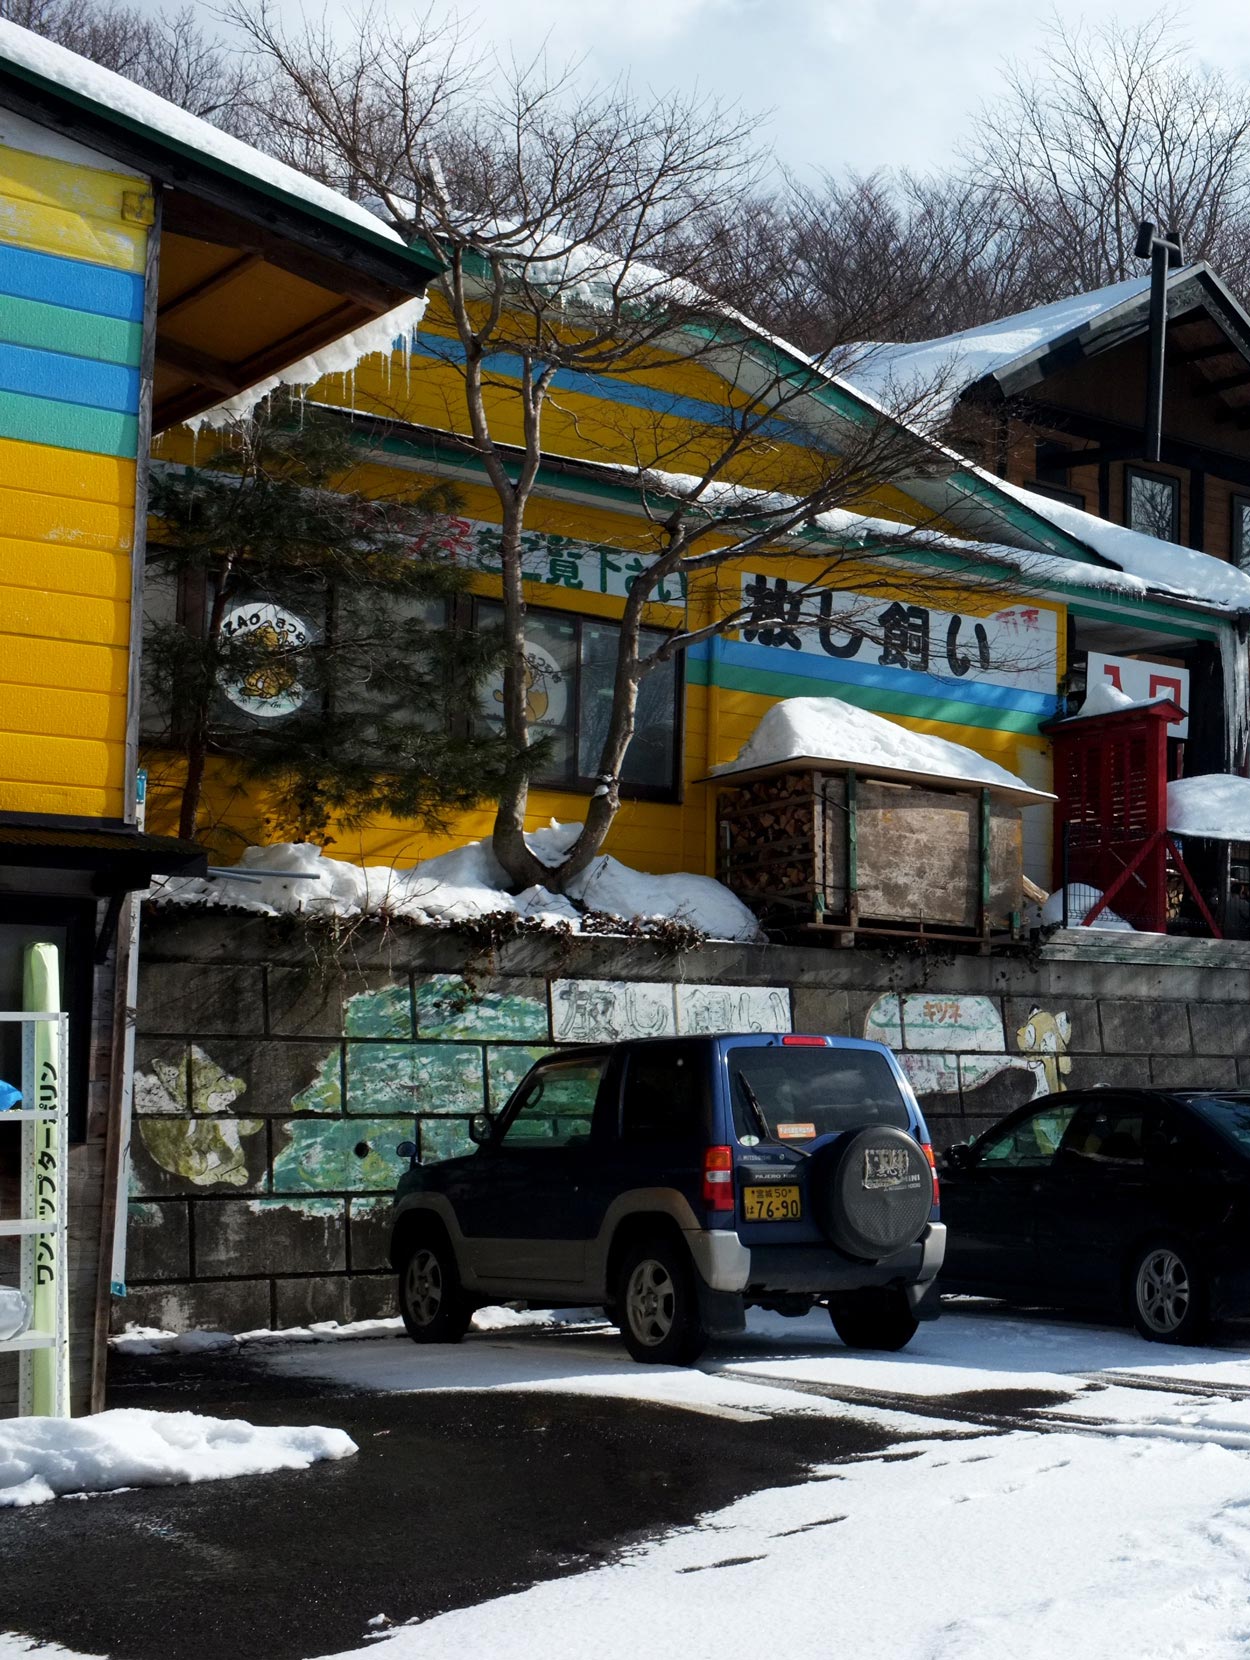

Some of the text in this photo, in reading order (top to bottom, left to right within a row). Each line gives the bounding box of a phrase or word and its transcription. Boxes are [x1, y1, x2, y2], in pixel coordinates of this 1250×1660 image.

[223, 612, 260, 636] ZAO
[742, 574, 990, 677] 放し飼い
[923, 1001, 962, 1023] キツネ
[775, 1189, 788, 1198] 50
[756, 1200, 799, 1218] 76-90
